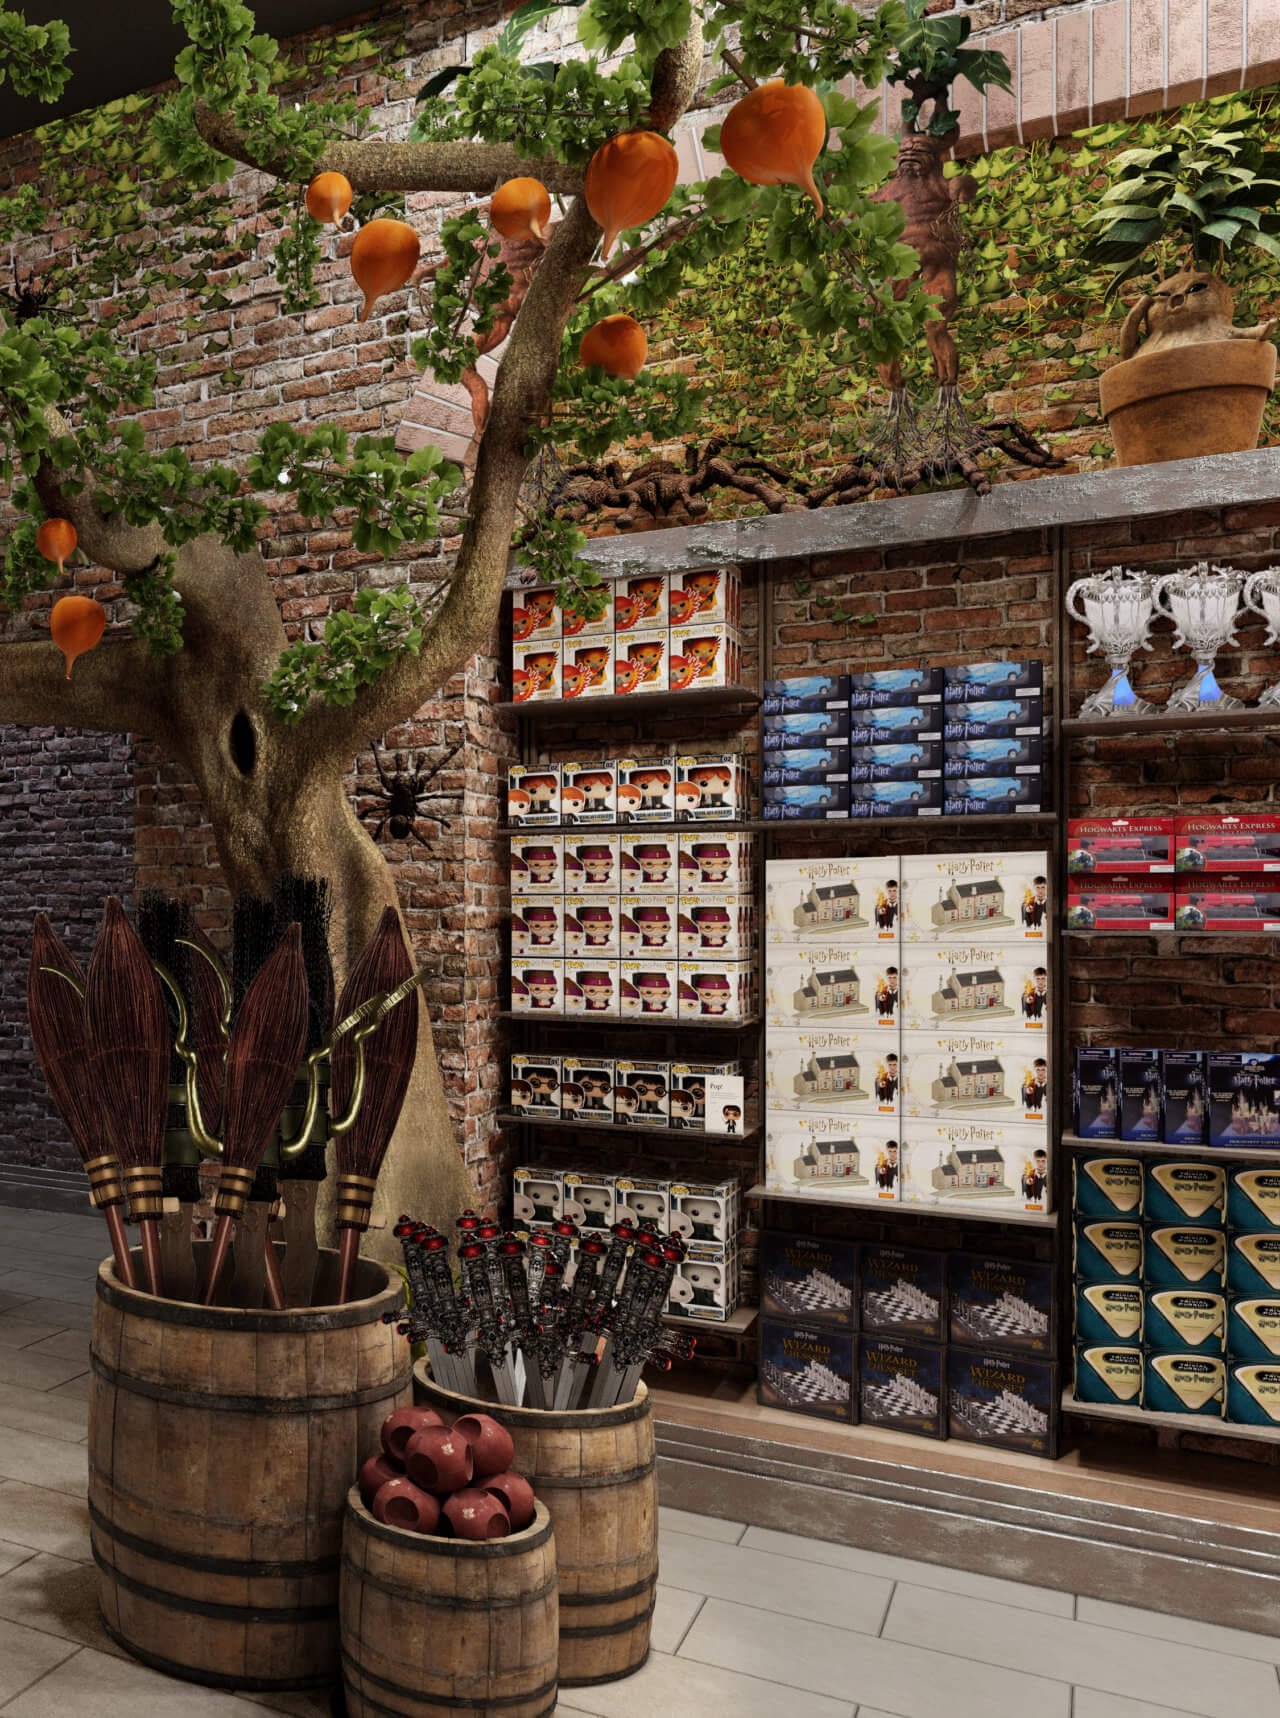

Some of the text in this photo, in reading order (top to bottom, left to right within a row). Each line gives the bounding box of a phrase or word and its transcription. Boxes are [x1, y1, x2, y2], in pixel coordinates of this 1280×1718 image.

[1080, 824, 1163, 833] HOGWARTS EXPRESS
[1187, 822, 1276, 831] HOGWARTS EXPRESS
[808, 864, 851, 878] Harry Potter
[948, 859, 995, 876] Harry Potter
[808, 949, 851, 965] Harry Potter
[948, 948, 995, 965] Harry Potter
[808, 1032, 851, 1048] Harry Potter
[948, 1037, 995, 1053] Harry Potter
[808, 1118, 851, 1133] Harry Potter
[948, 1126, 995, 1142] Harry Potter
[782, 1337, 831, 1354] WIZARD
[866, 1351, 918, 1368] WIZARD
[970, 1365, 1025, 1384] WIZARD
